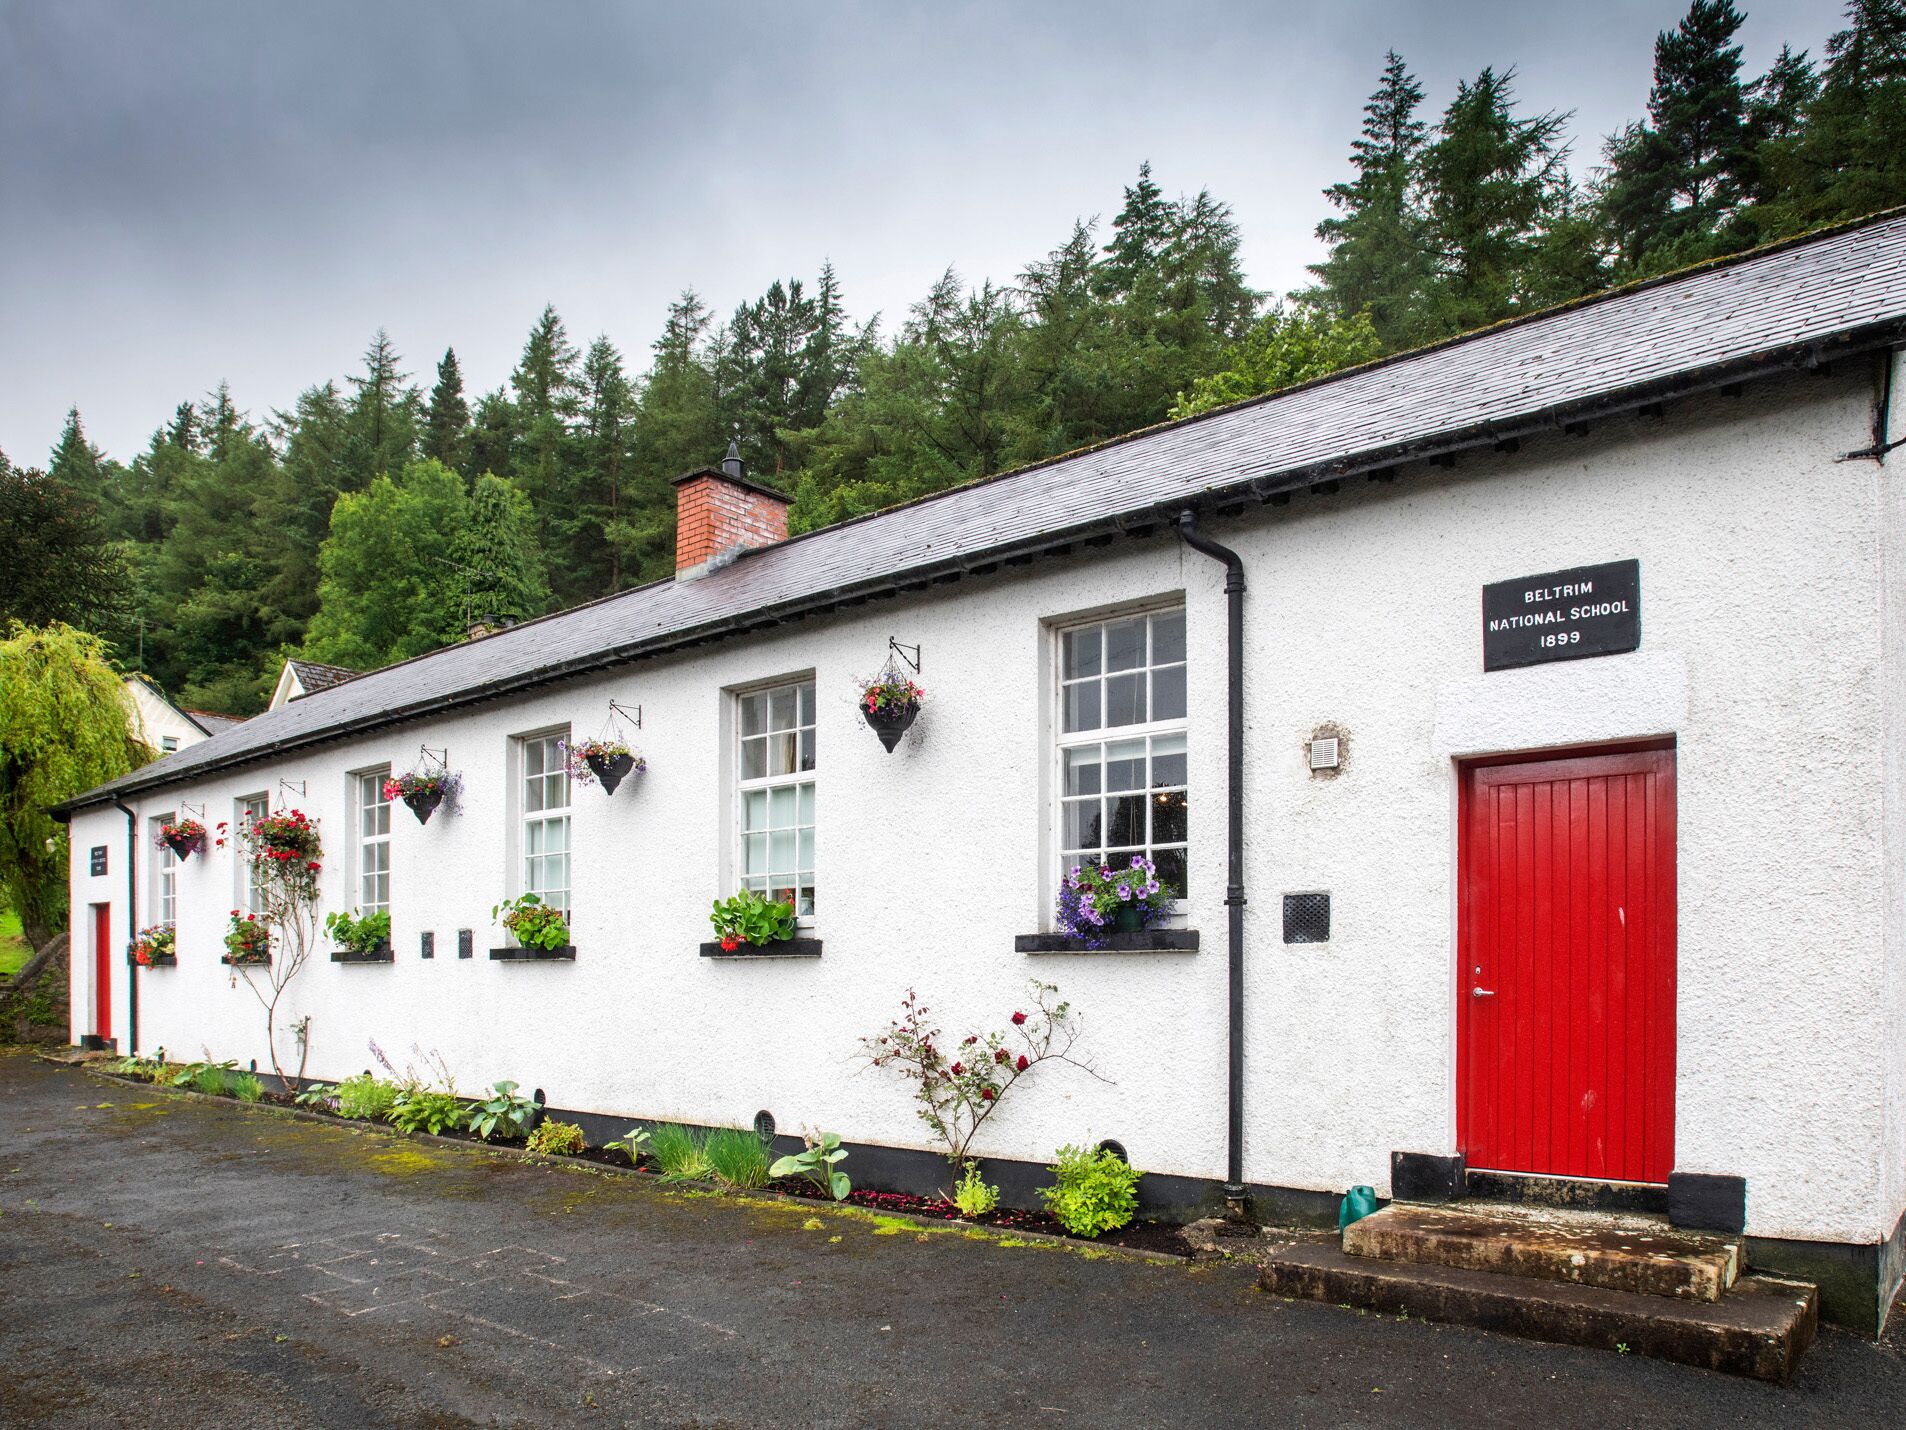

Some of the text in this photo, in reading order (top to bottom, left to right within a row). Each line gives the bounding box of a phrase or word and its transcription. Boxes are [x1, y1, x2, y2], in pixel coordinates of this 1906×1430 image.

[1525, 581, 1593, 603] BELTRIM
[1490, 600, 1630, 632] NATIONAL SCHOOL
[1540, 631, 1581, 648] 1899
